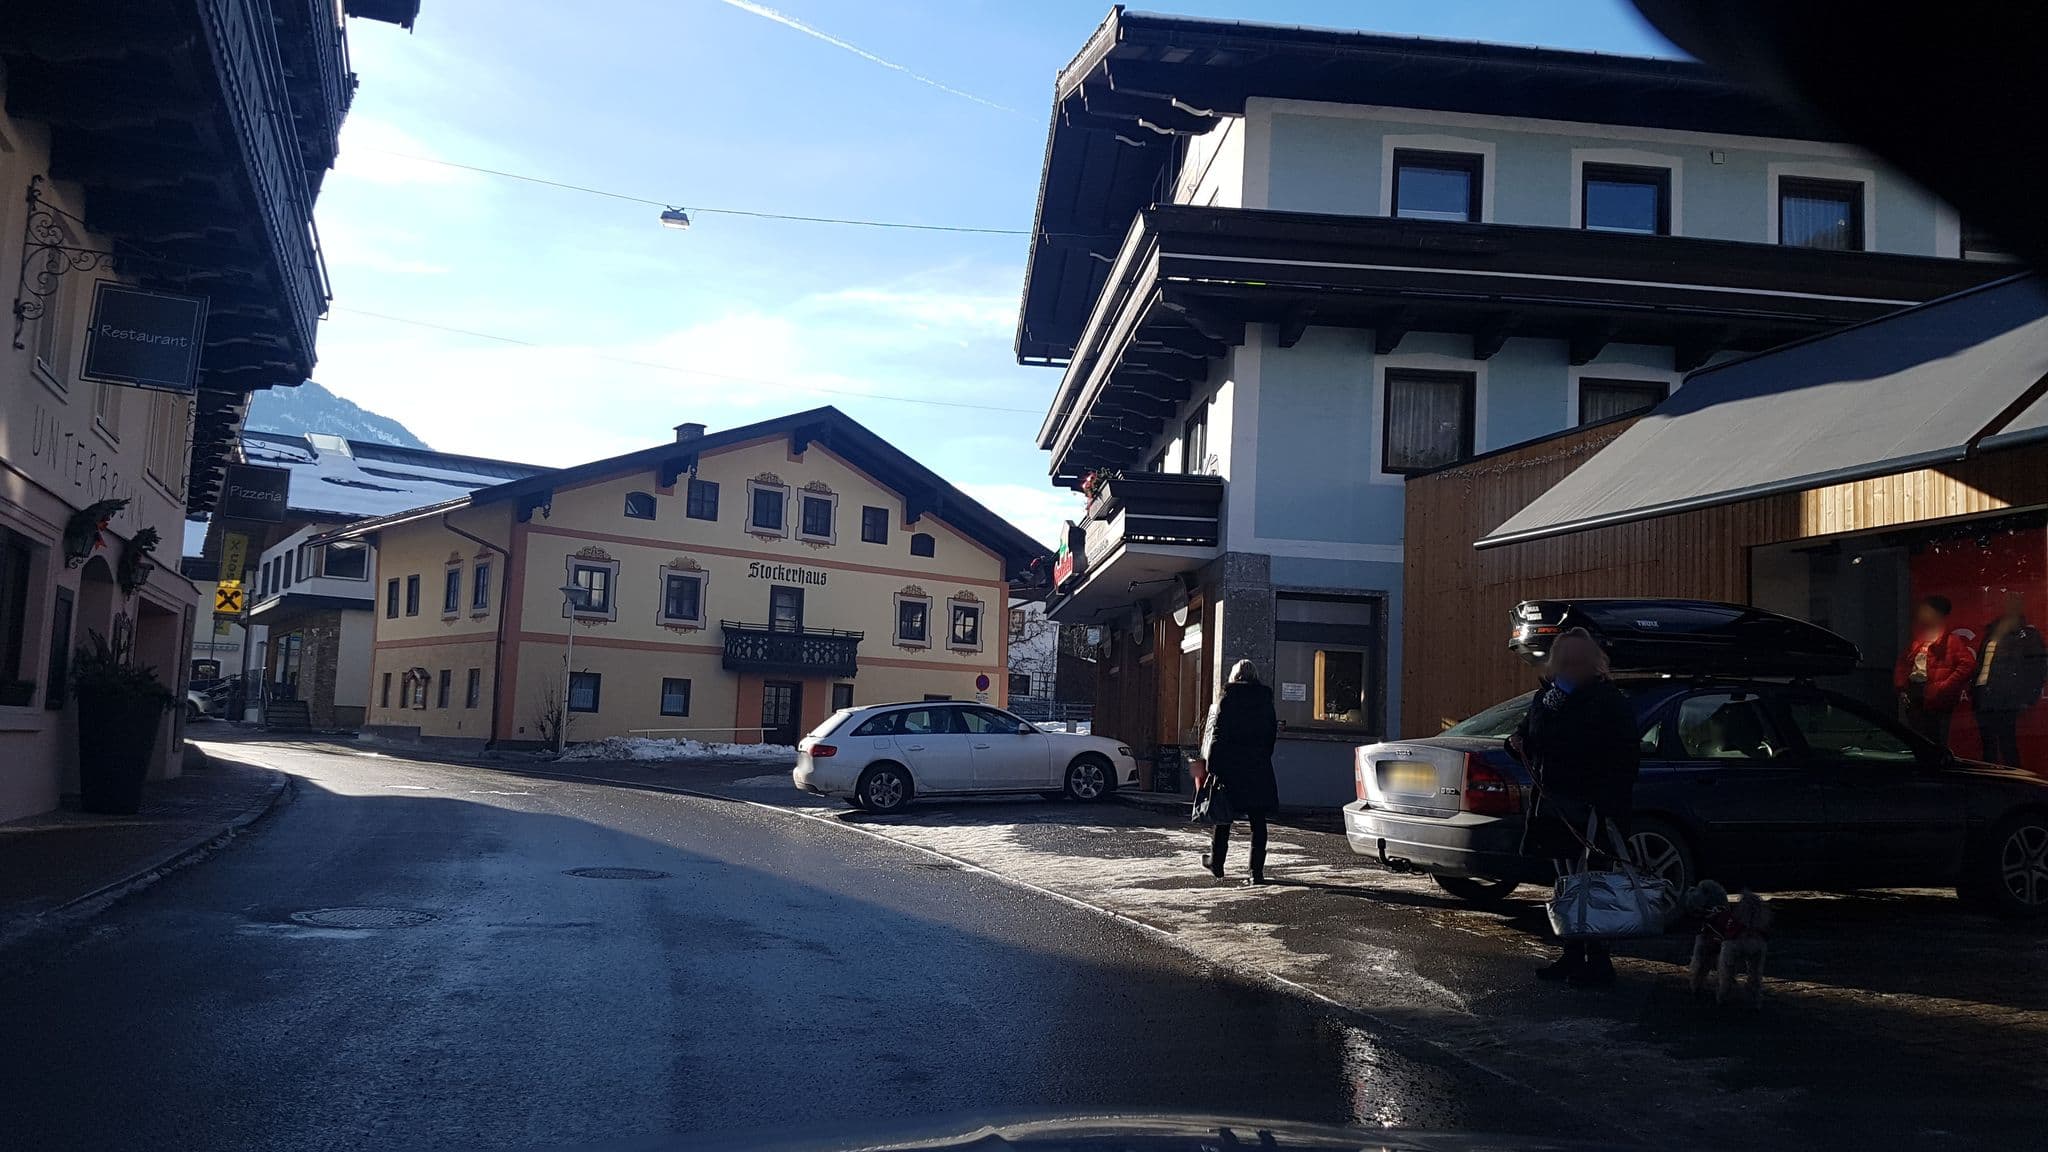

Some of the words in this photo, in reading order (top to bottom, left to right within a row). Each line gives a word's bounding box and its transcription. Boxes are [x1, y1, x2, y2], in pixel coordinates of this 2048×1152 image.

[101, 324, 188, 347] Restaurant
[229, 485, 282, 502] Pizzeria
[747, 561, 828, 586] Stockerhaus
